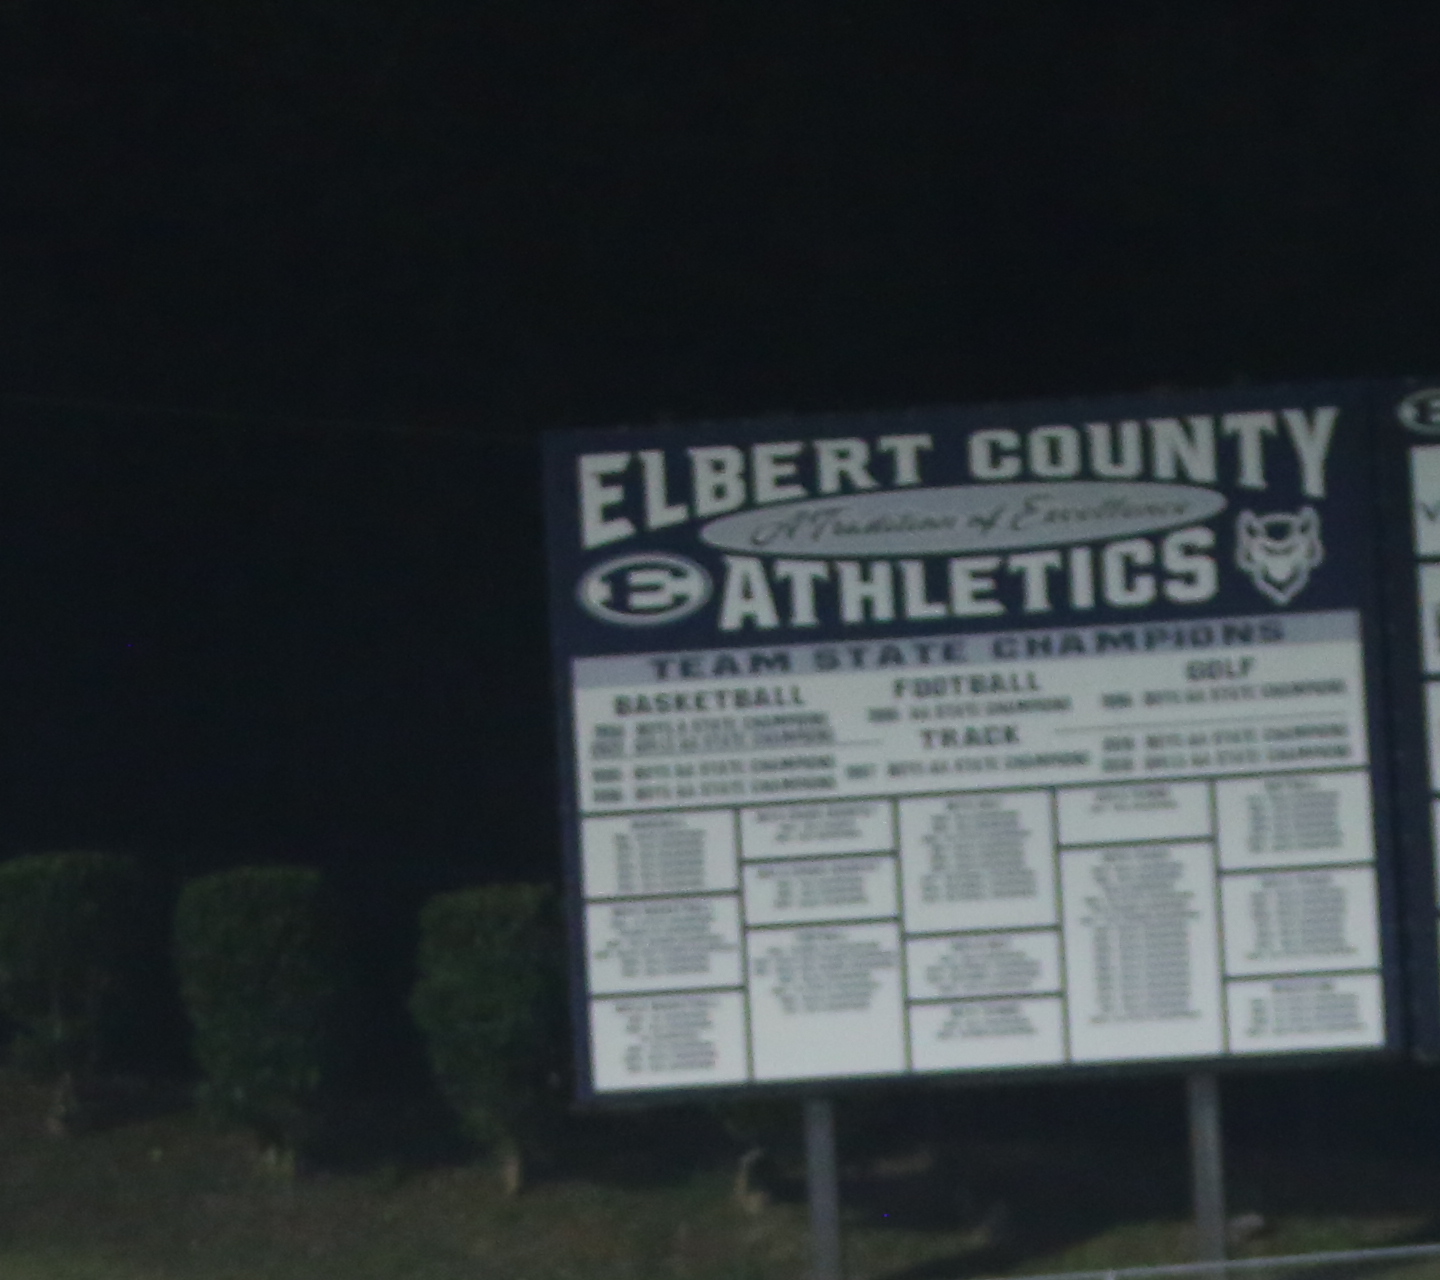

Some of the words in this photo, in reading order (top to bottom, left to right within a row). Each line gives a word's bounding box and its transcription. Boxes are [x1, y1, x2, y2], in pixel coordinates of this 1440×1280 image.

[576, 434, 933, 549] ELBERT
[967, 407, 1340, 498] COUNTY
[718, 528, 1221, 632] ATHLETICS
[653, 651, 792, 680] TEAM
[813, 641, 969, 674] STATE
[992, 620, 1286, 659] CHAMPIONS
[893, 670, 1039, 699] FOOTBALL
[1184, 655, 1257, 682] GOLF
[613, 684, 805, 716] BASKETBALL
[919, 724, 1020, 750] TRACK
